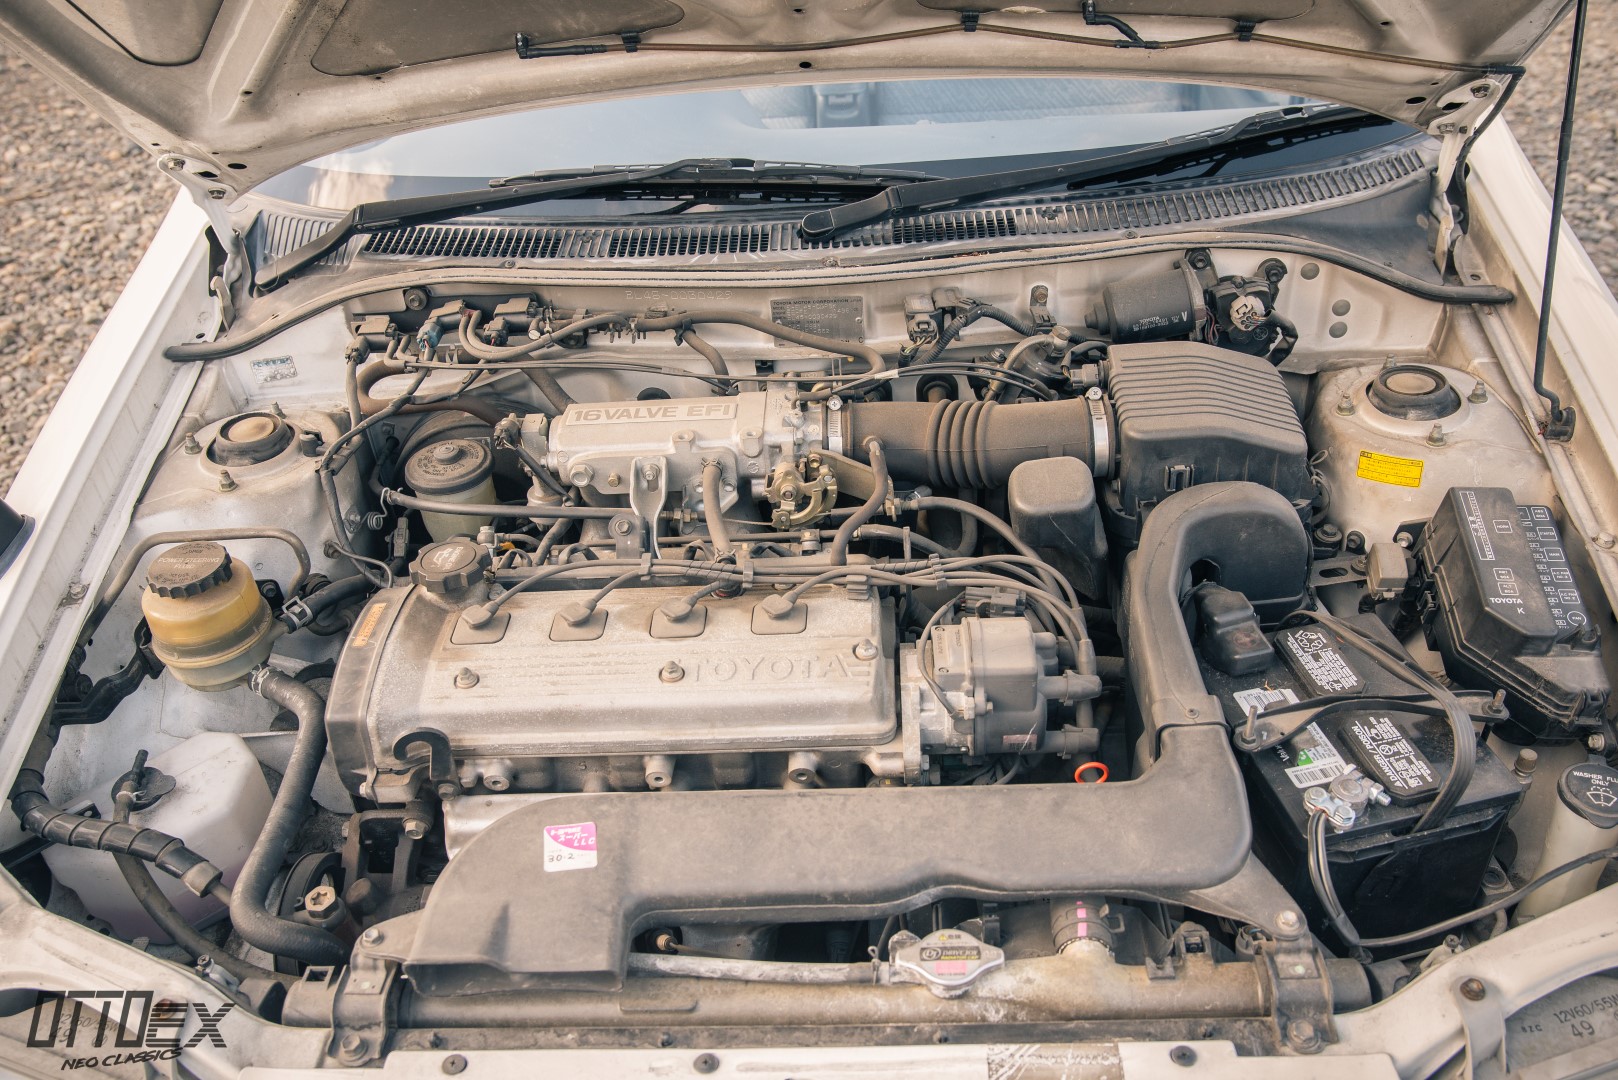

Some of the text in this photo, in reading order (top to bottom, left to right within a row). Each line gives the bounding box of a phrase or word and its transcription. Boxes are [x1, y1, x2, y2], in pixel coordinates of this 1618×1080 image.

[574, 404, 731, 422] 16VALVE EFI
[1516, 607, 1526, 615] K
[682, 654, 850, 683] TOYOTA
[1351, 725, 1375, 750] POISON
[1373, 754, 1399, 782] DANGER
[1572, 770, 1603, 780] WASHER
[1591, 779, 1610, 787] ONLY
[1570, 1020, 1595, 1038] 49
